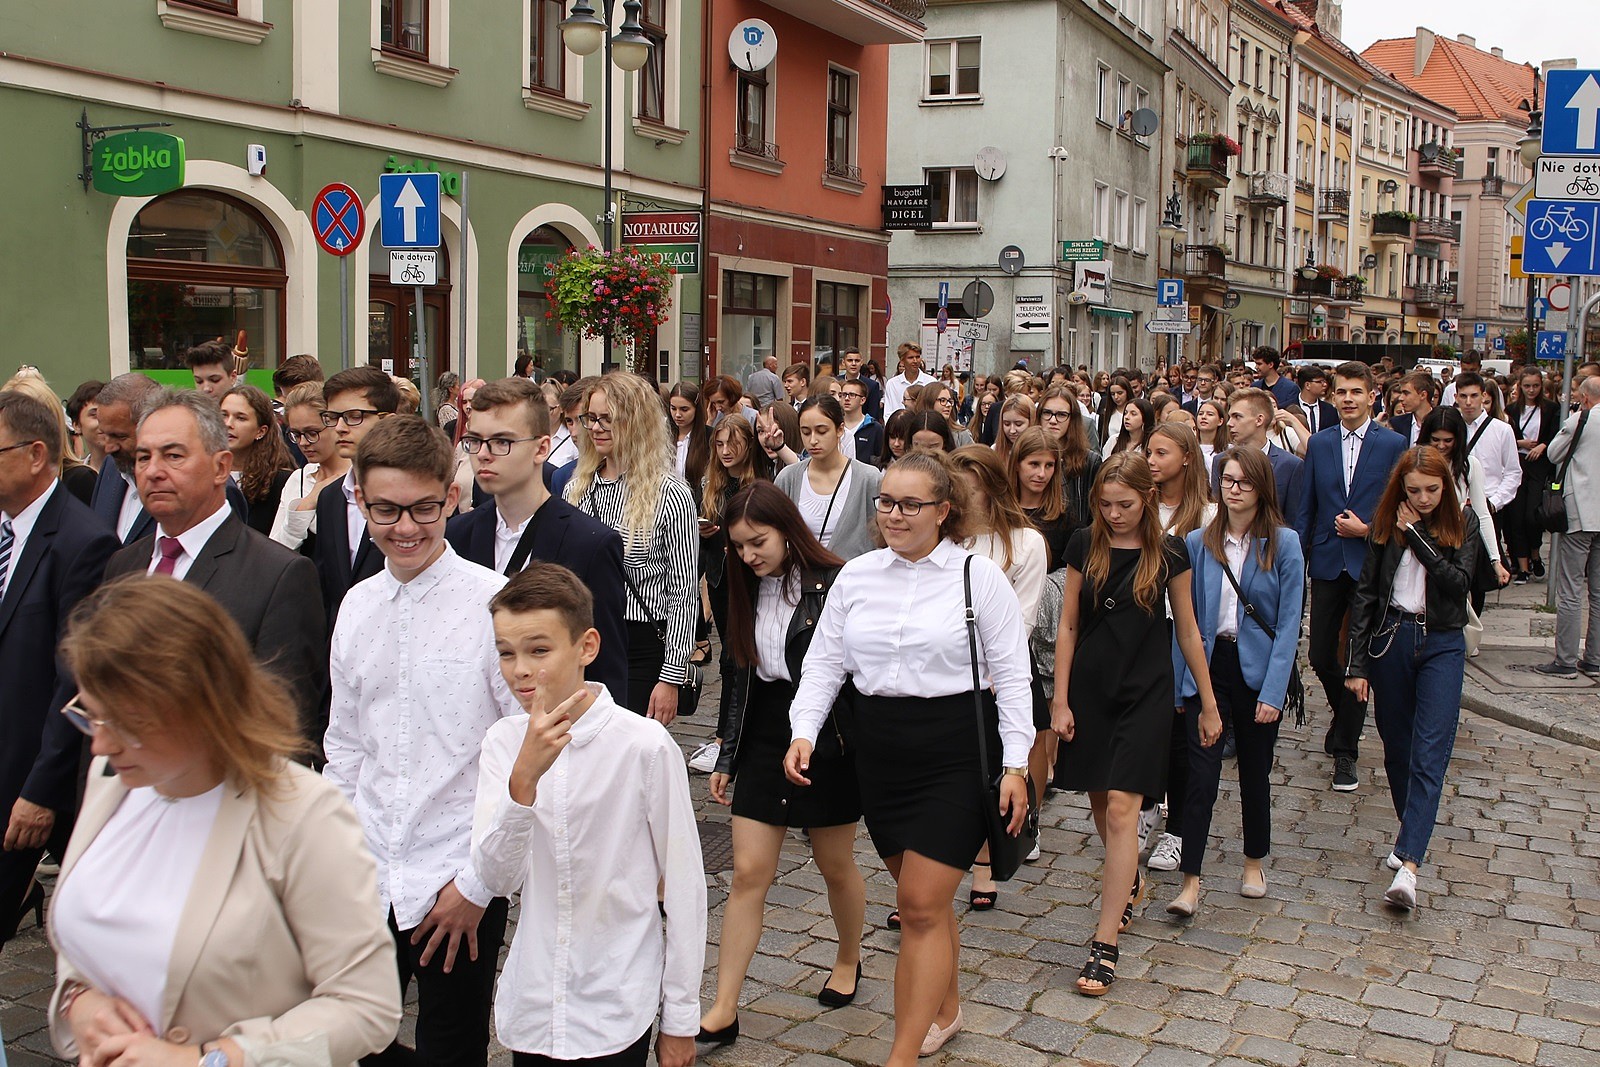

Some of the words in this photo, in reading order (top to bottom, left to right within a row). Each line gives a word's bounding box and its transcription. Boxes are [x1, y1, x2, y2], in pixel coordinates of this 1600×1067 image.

[102, 145, 171, 171] żabka
[1542, 161, 1565, 172] Nie
[894, 187, 922, 199] bugatti
[892, 210, 924, 219] DIGEL
[623, 222, 699, 236] NOTARIUSZ
[391, 252, 404, 261] Nie
[406, 253, 435, 263] dotyczy
